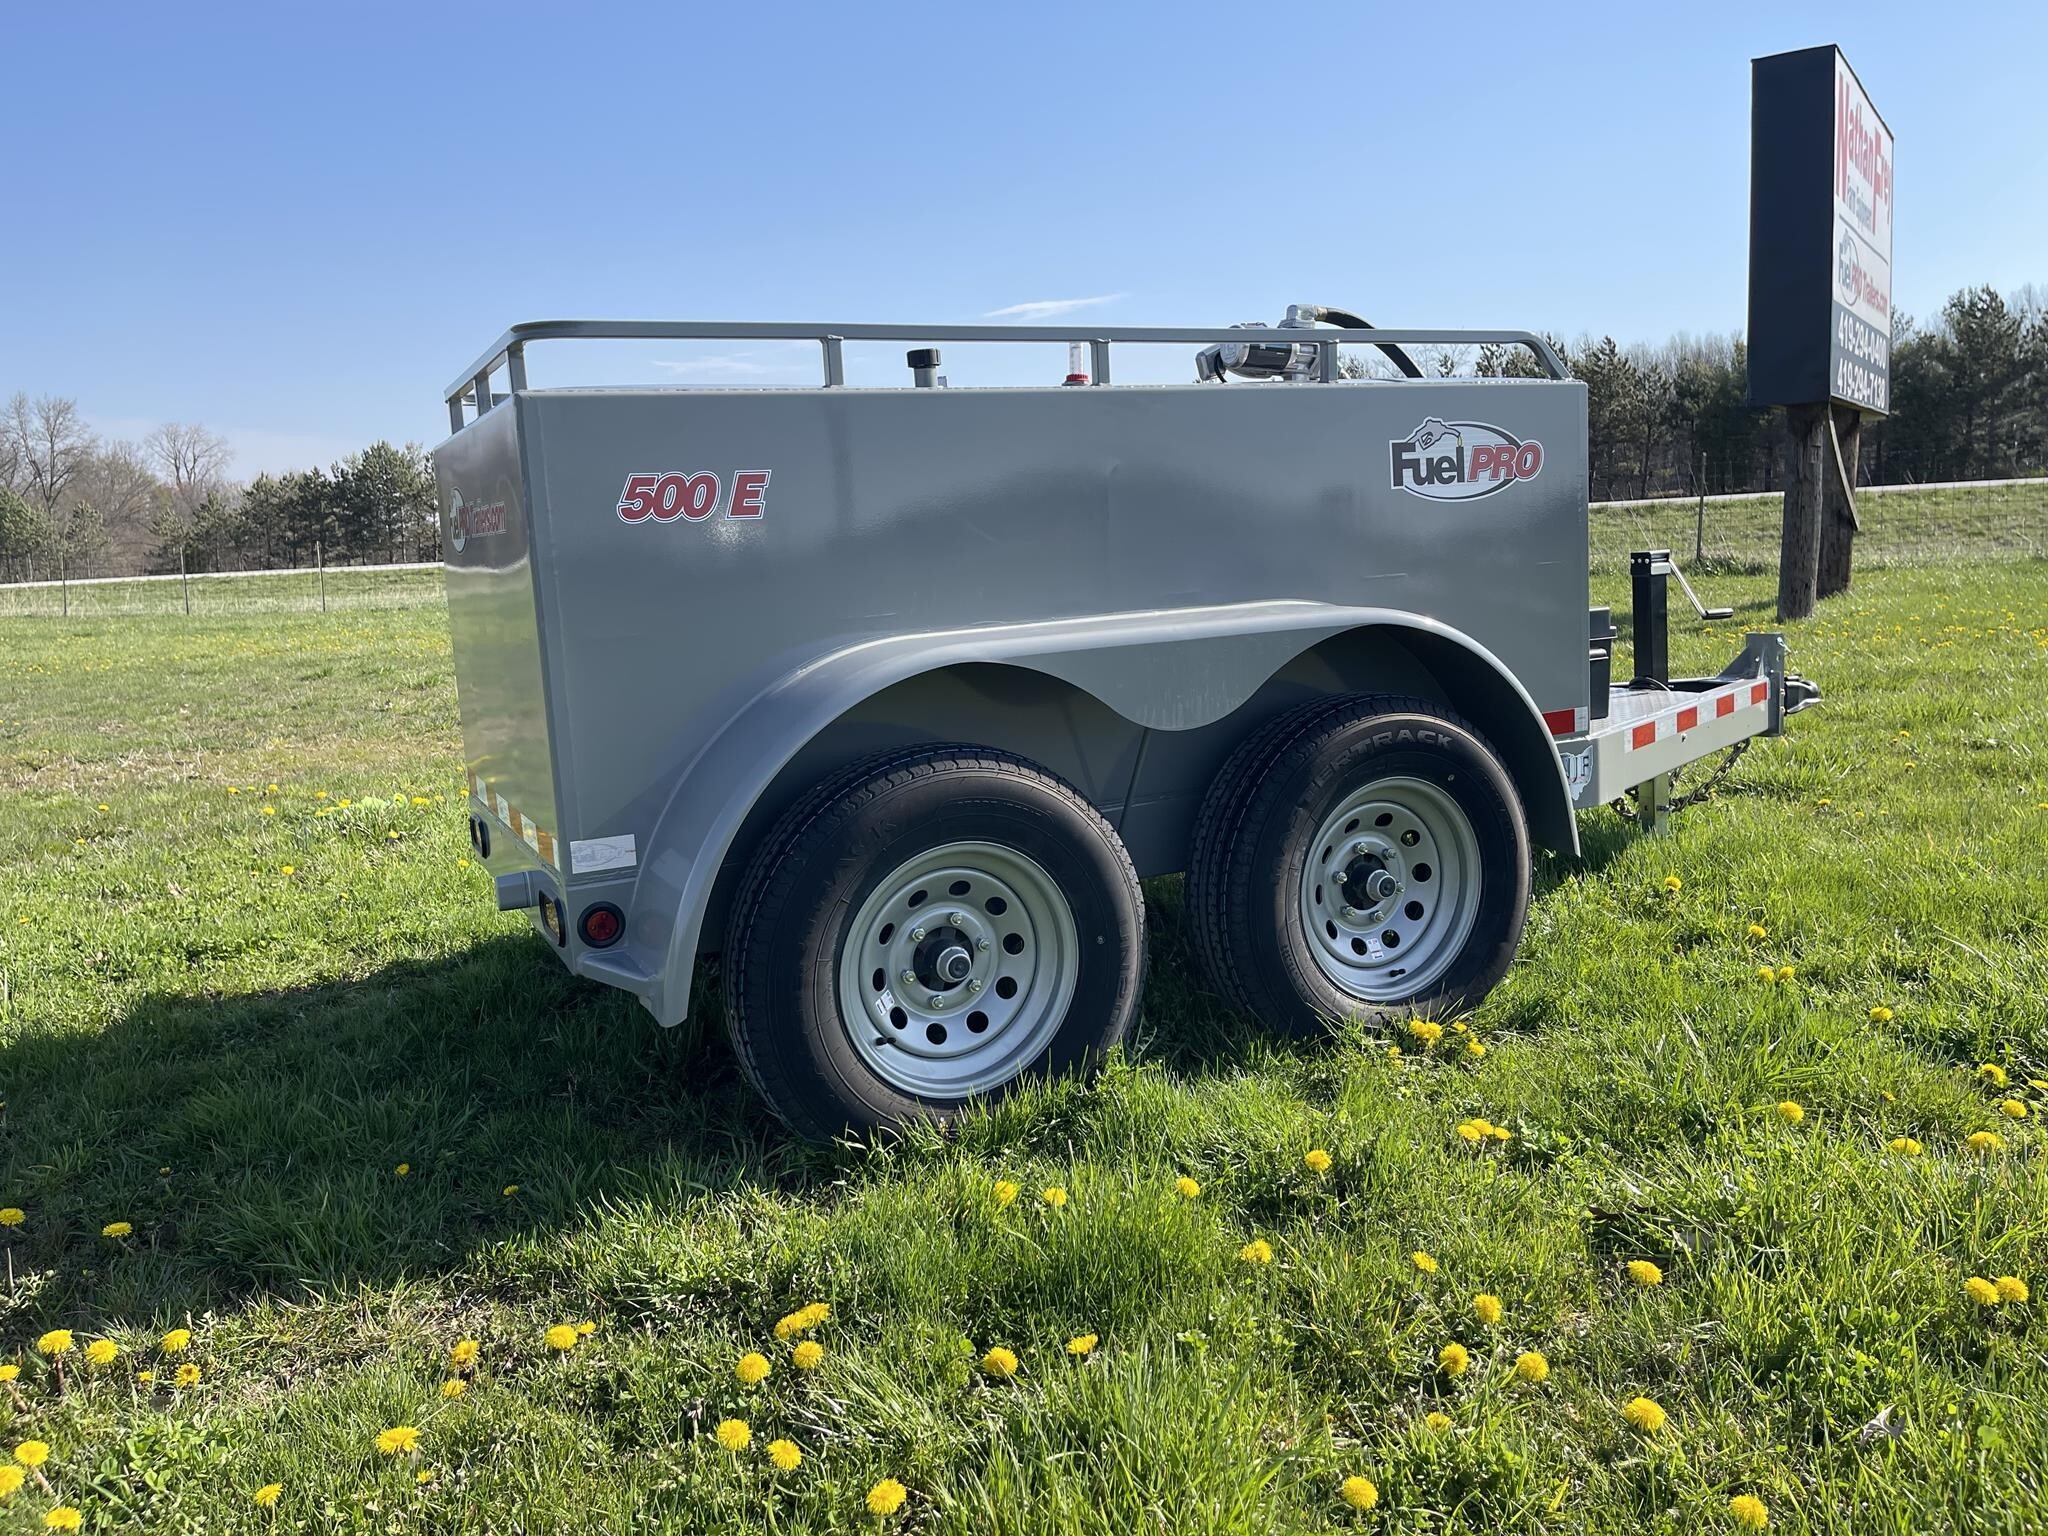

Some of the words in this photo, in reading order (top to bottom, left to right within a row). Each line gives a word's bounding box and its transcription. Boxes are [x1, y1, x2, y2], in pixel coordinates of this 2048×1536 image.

[1836, 72, 1873, 203] Nathan
[1838, 311, 1887, 370] 419-294-0400
[616, 470, 721, 524] 500
[725, 469, 771, 520] E
